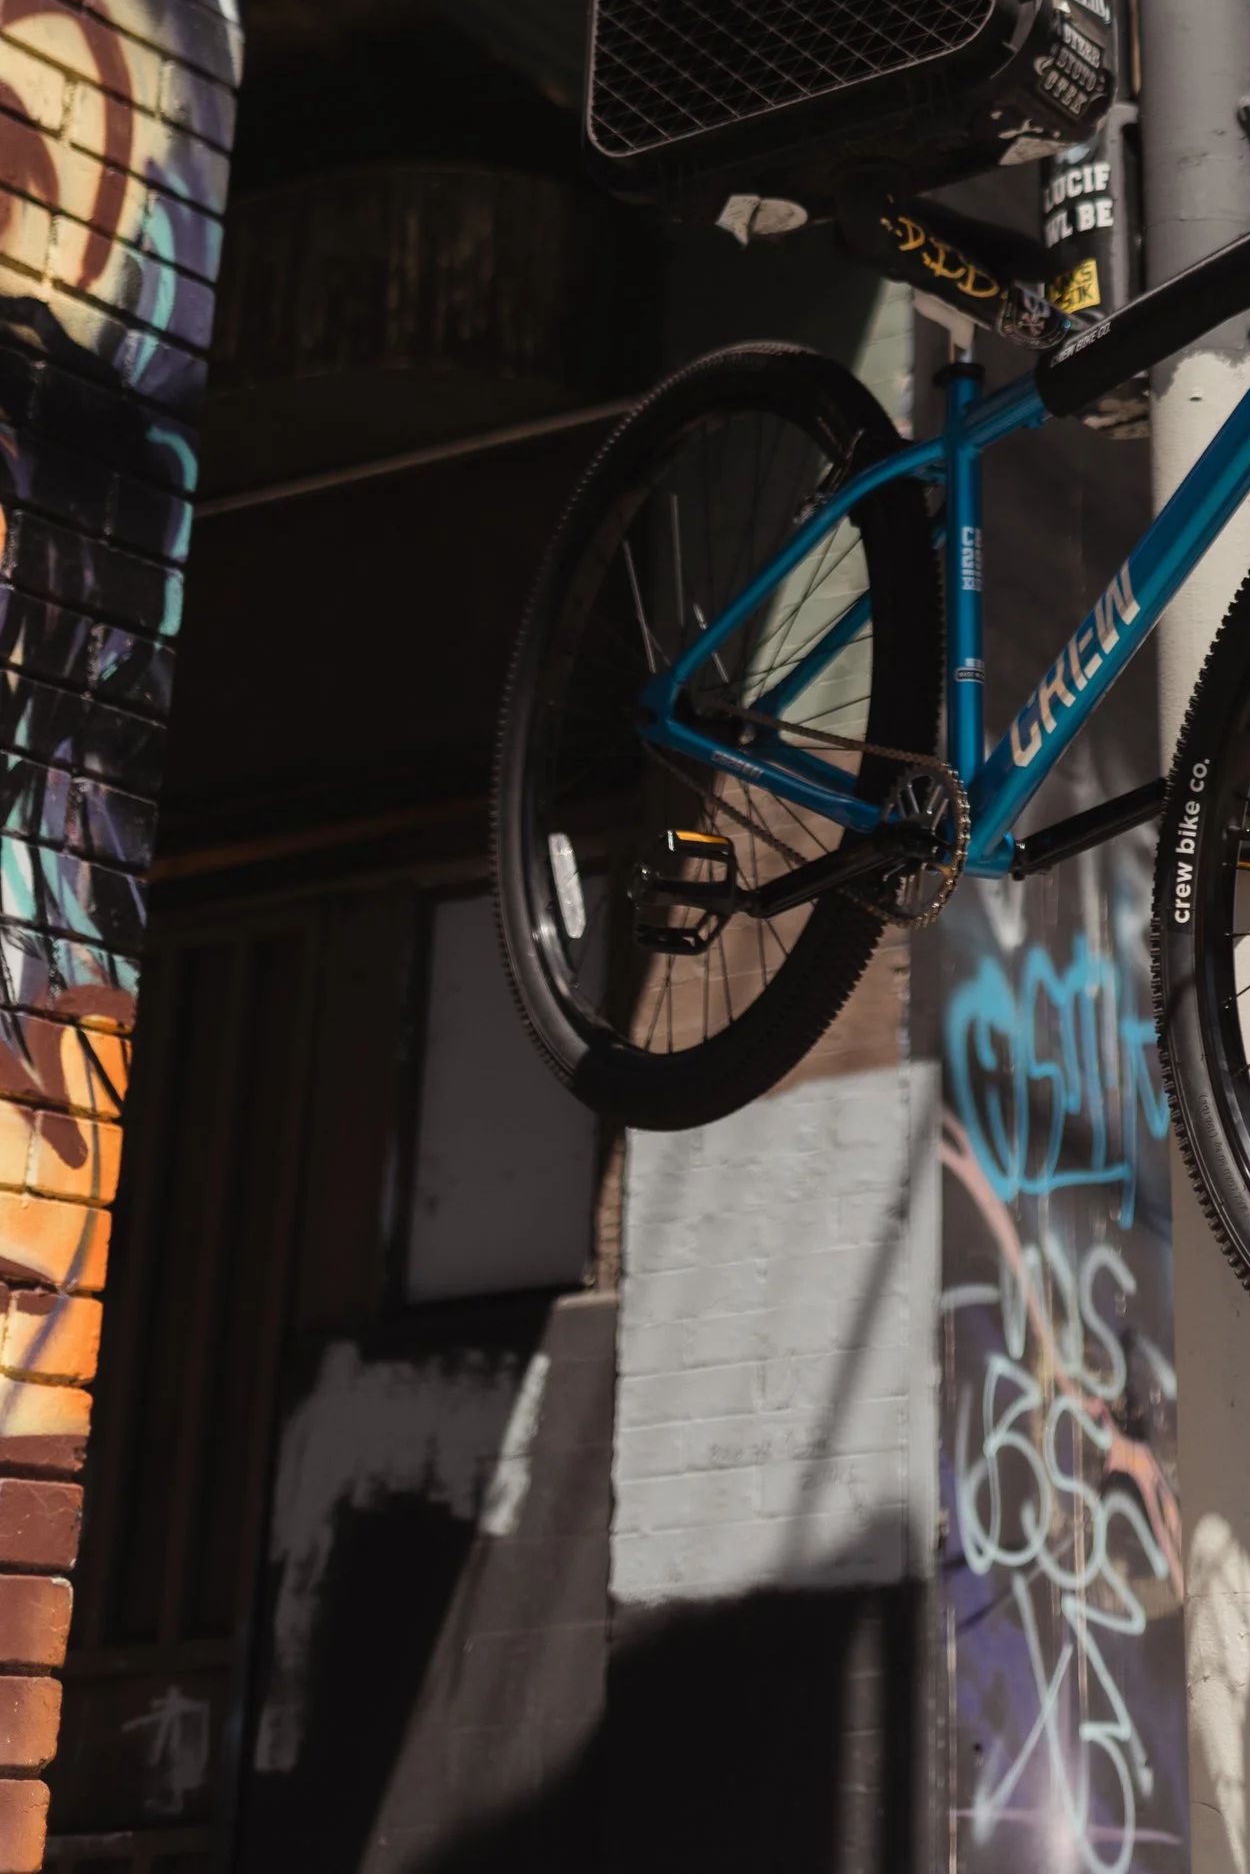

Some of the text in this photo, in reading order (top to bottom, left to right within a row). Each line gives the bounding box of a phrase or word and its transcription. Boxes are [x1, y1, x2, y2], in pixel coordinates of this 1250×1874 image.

[1076, 198, 1114, 232] BE
[1009, 559, 1141, 768] CREW
[1173, 758, 1210, 924] crew bike co.
